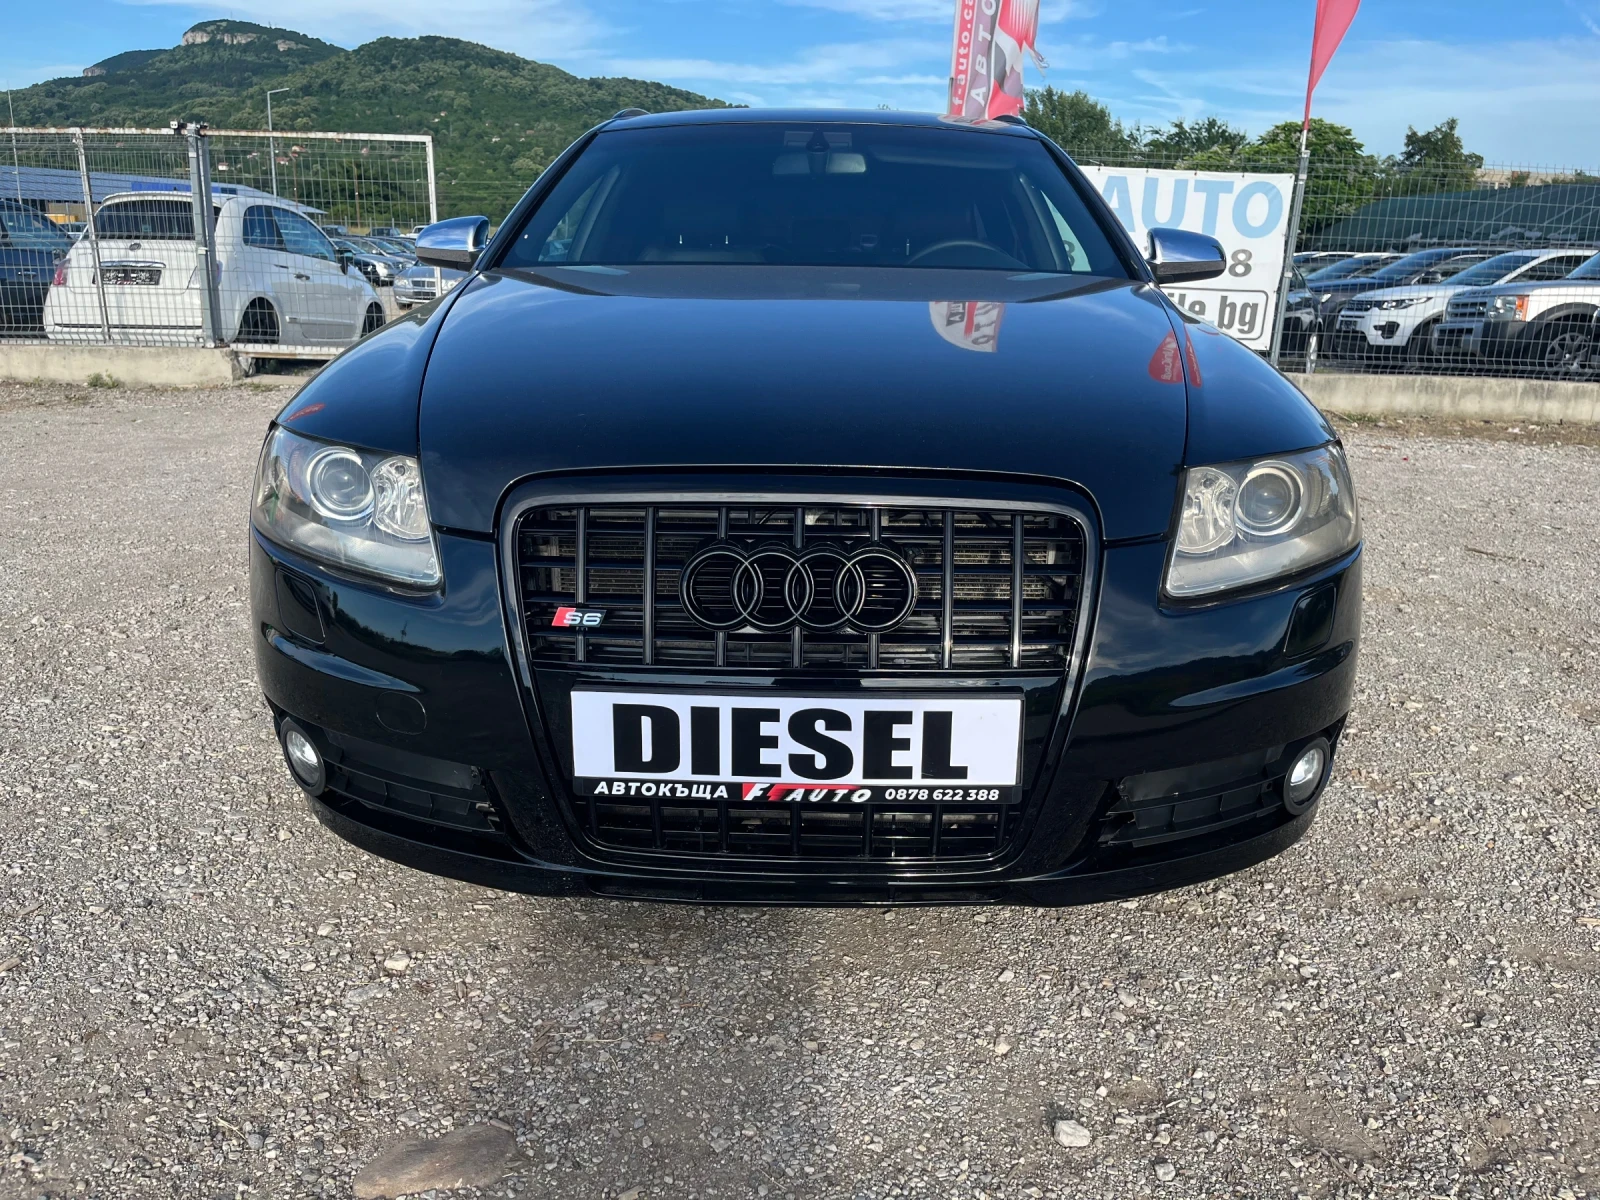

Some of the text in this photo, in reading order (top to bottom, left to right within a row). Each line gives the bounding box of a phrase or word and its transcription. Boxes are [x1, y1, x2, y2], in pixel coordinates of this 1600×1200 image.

[1100, 175, 1284, 239] AUTO
[563, 611, 602, 625] S6
[612, 703, 968, 780] DIESEL
[593, 781, 729, 799] АВТОКЪЩА
[784, 788, 871, 802] AUTO
[885, 788, 1000, 801] 0878 622 388
